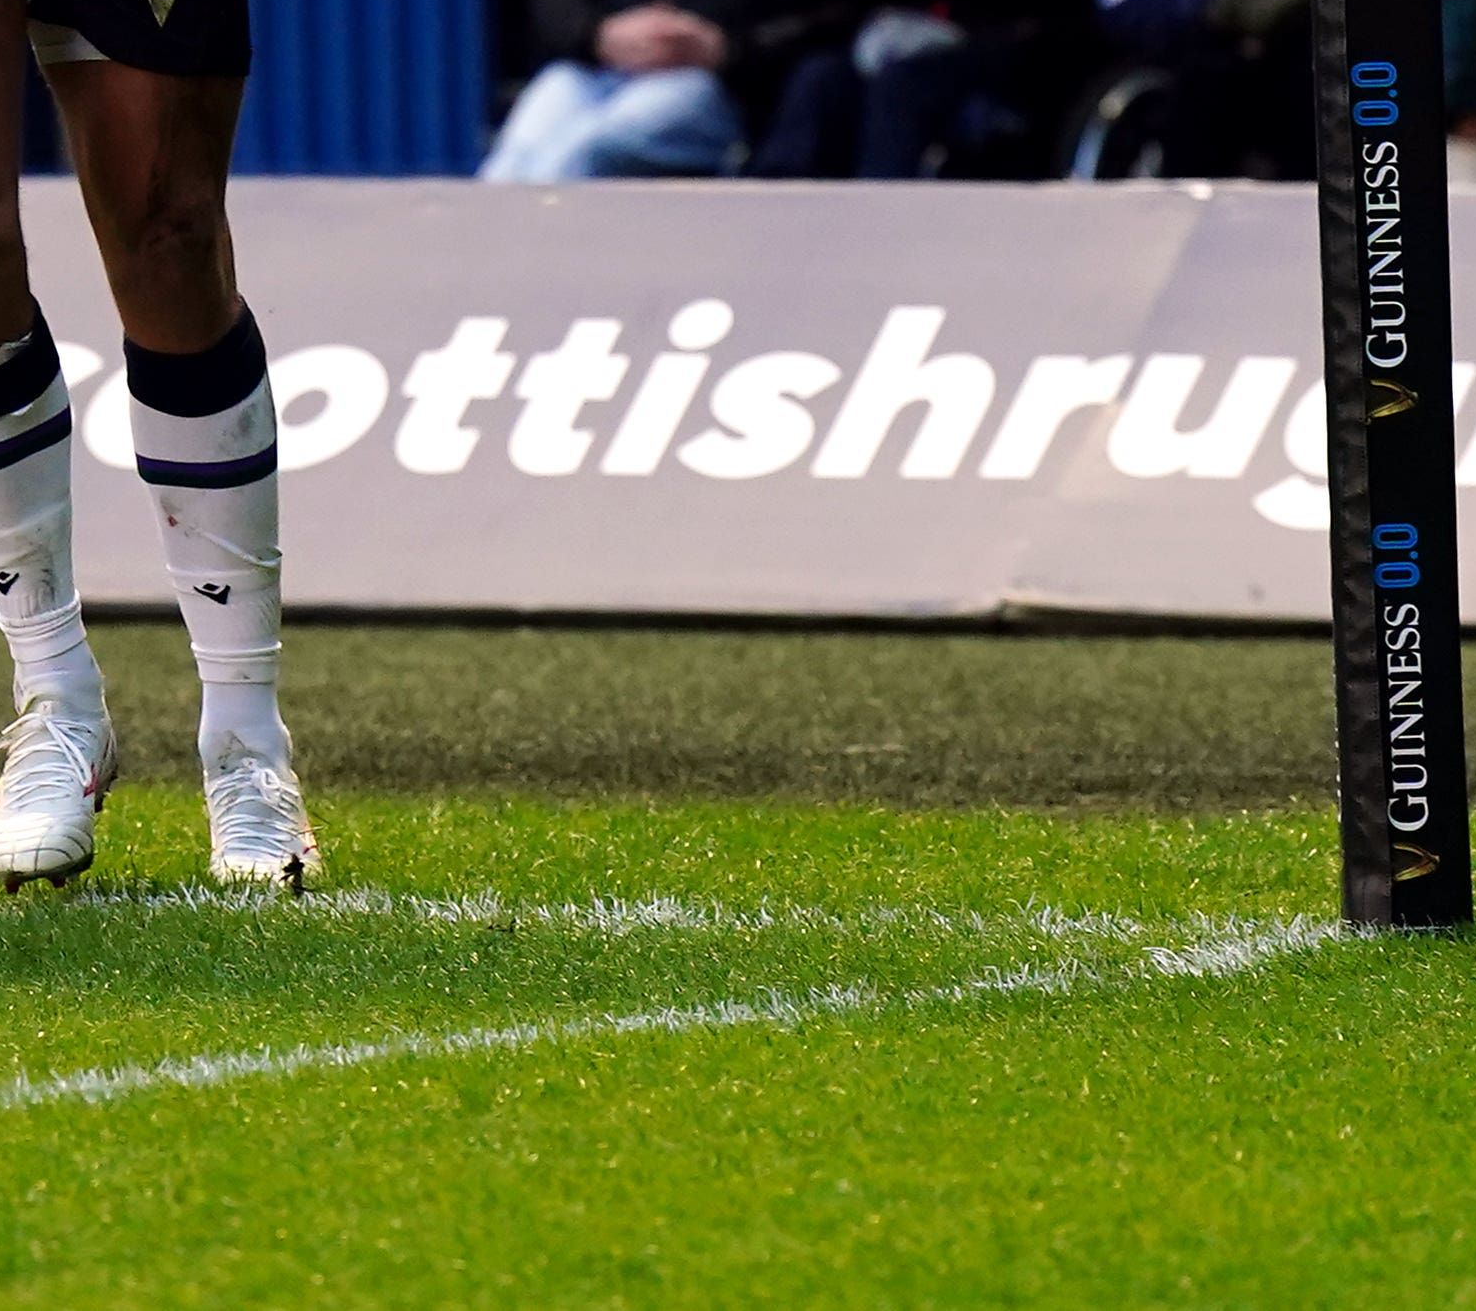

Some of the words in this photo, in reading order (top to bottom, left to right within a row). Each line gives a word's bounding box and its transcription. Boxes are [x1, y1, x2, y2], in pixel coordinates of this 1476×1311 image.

[1351, 61, 1399, 127] 0.0
[1362, 141, 1408, 369] GUINNESS
[1372, 523, 1421, 589] 0.0
[1384, 602, 1430, 833] GUINNESS
